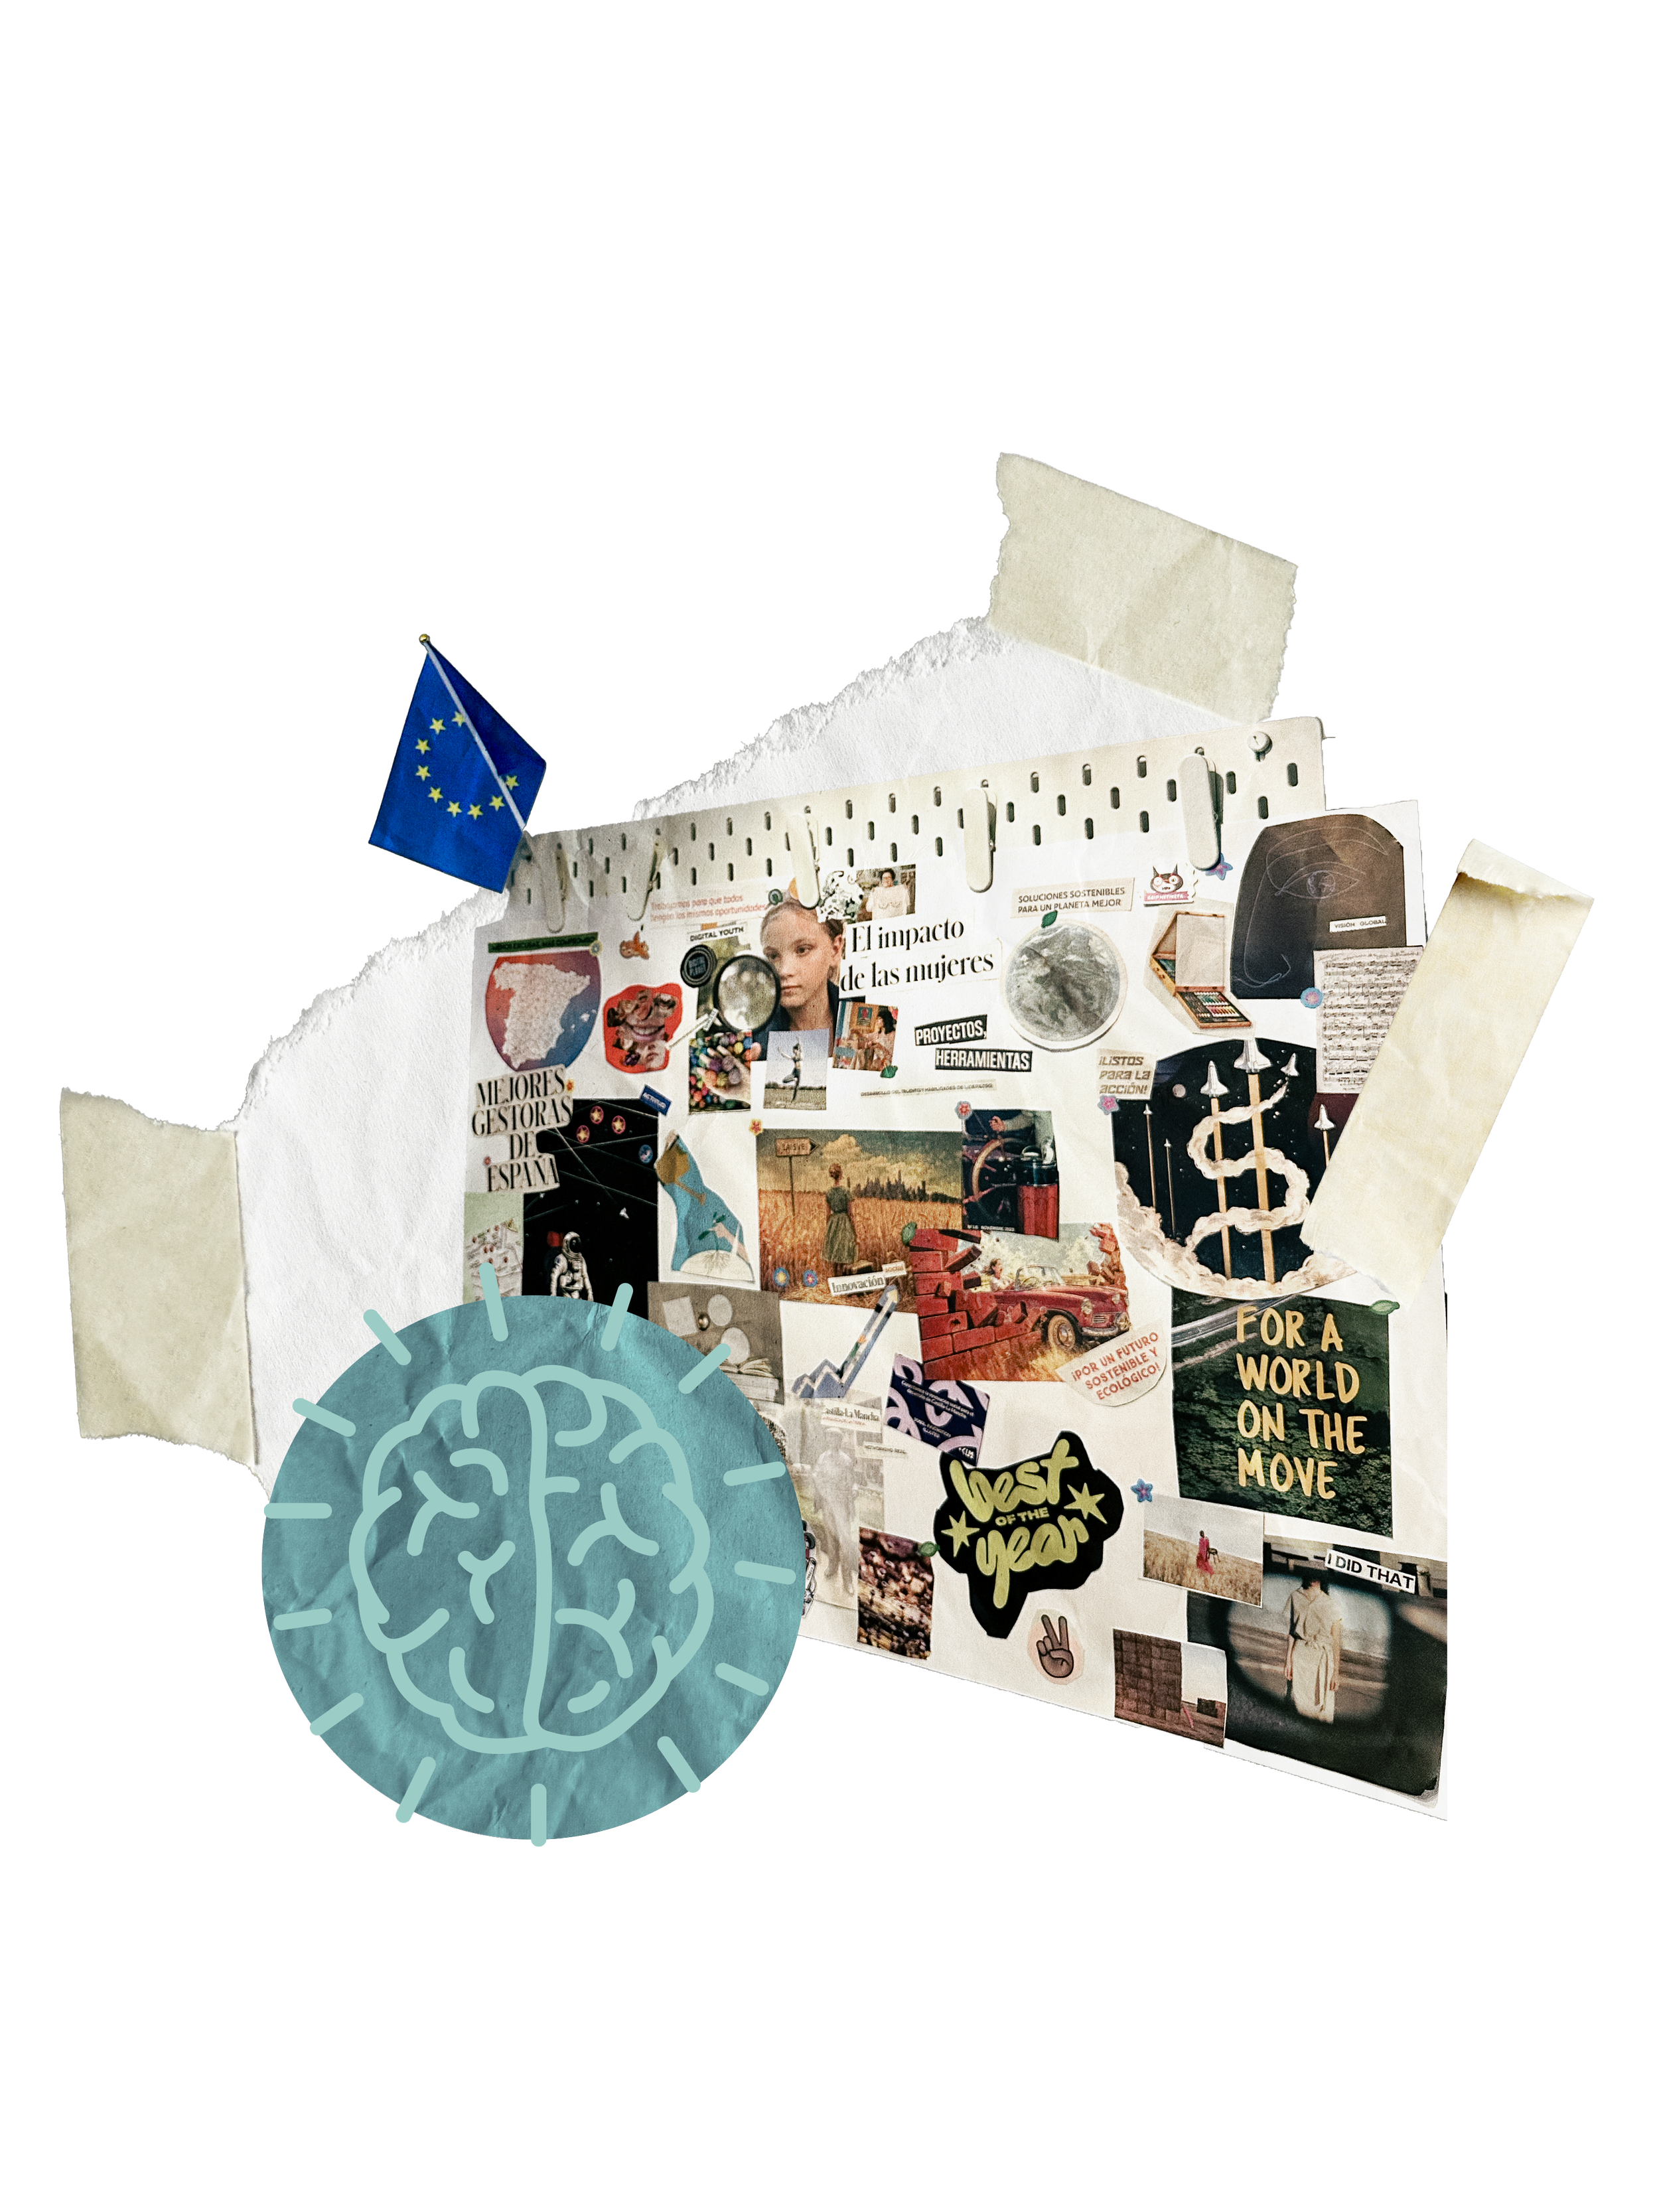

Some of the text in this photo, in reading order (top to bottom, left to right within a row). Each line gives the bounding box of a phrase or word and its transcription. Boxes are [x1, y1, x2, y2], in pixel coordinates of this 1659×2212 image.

[1018, 887, 1125, 903] SOLUCIONES SOSTENIBLES
[1018, 905, 1038, 913] PARA
[1054, 901, 1089, 911] PLANETA
[1092, 898, 1121, 907] MEJOR
[689, 926, 744, 941] DIGITAL YOUTH
[852, 918, 964, 952] El impacto
[840, 954, 993, 992] de las mujeres
[916, 1019, 987, 1045] PROYECTOS,
[936, 1049, 1029, 1070] HERRAMIENTAS
[477, 1068, 564, 1108] MEJORES
[472, 1096, 572, 1136] GESTORAS
[510, 1131, 536, 1159] DE
[488, 1155, 559, 1192] ESPAÑA
[831, 1276, 884, 1293] Innovación
[1236, 1305, 1343, 1352] FOR A
[1071, 1332, 1159, 1381] ¡POR UN FUTURO
[1085, 1347, 1157, 1389] SOSTENIBLE Y
[1096, 1362, 1161, 1400] ECOLÓGICO!
[1236, 1353, 1360, 1404] WORLD
[854, 1409, 879, 1421] Mancha
[1237, 1399, 1368, 1455] ON THE
[949, 1439, 1080, 1523] best
[1238, 1447, 1338, 1500] MOVE
[995, 1507, 1050, 1526] OF THE
[975, 1514, 1090, 1609] year
[1327, 1553, 1414, 1589] I DID THAT
